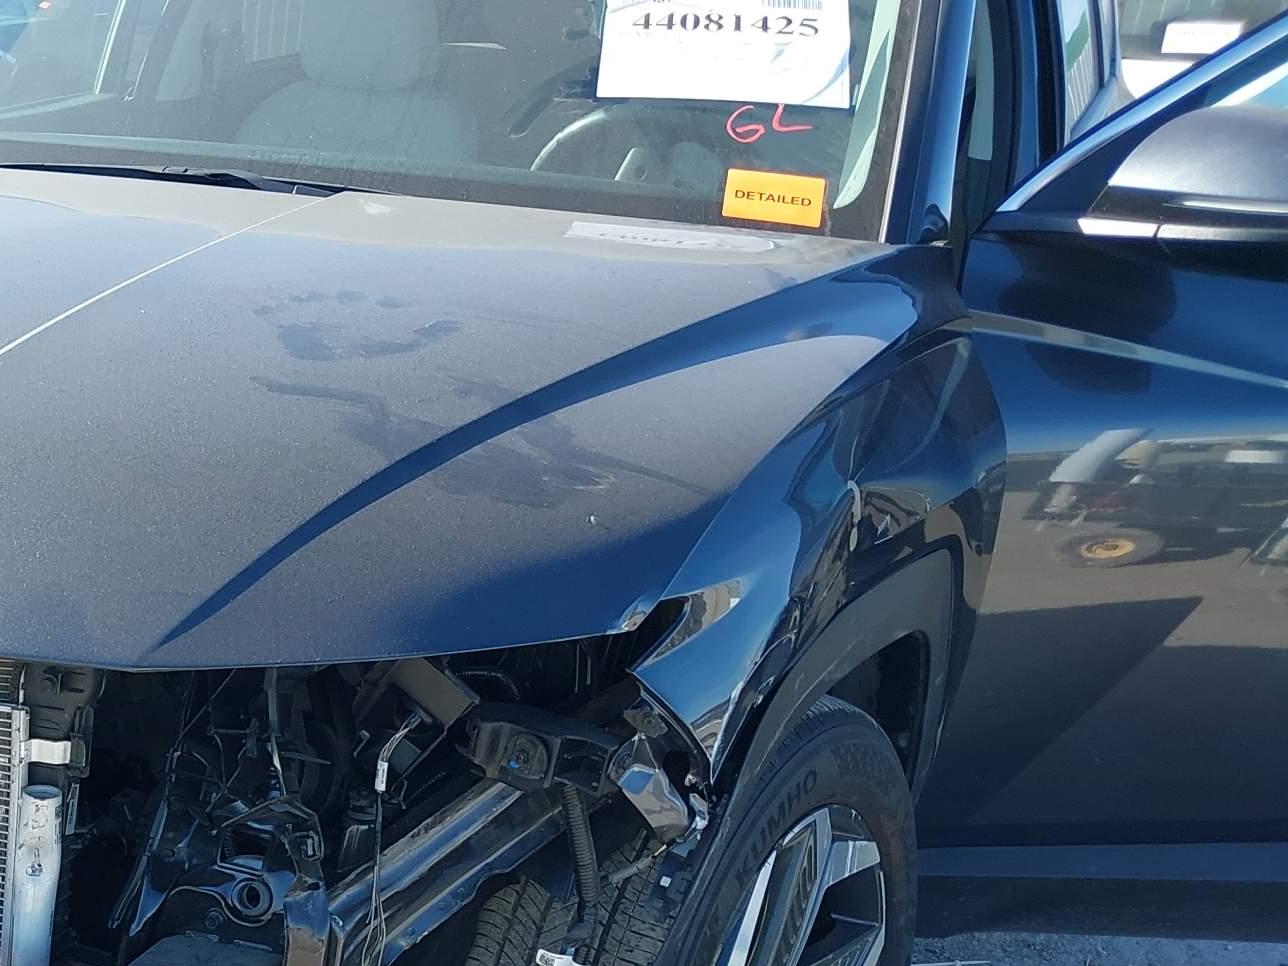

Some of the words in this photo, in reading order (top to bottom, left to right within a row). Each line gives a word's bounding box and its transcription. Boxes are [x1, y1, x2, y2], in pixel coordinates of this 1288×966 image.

[632, 12, 820, 37] 44081425
[734, 189, 812, 206] DETAILED
[735, 769, 818, 890] KUMHO
